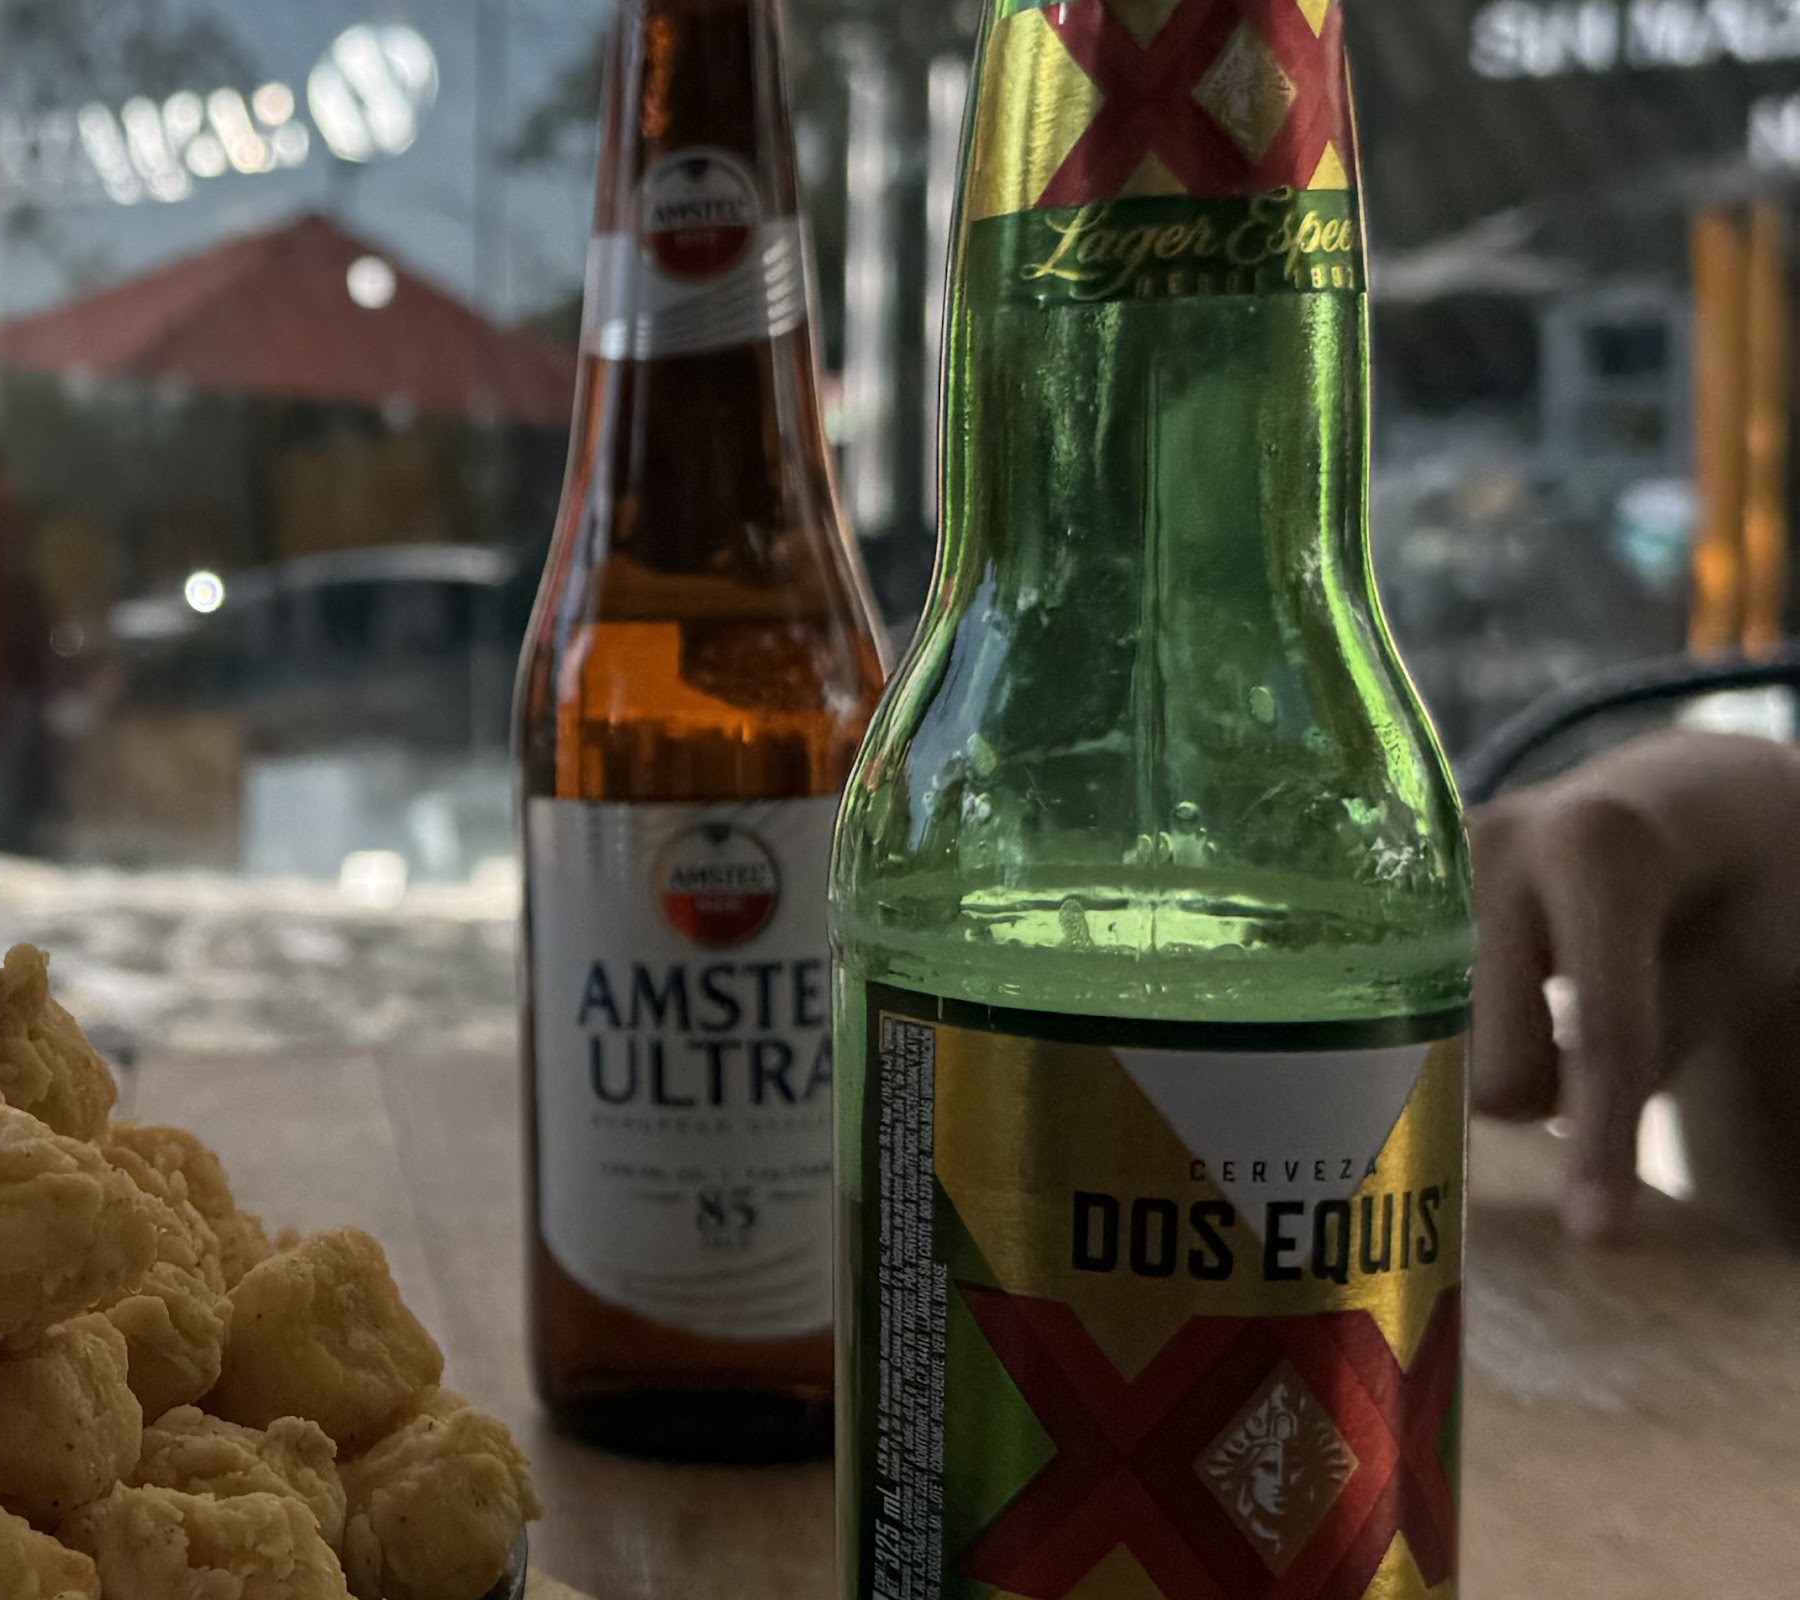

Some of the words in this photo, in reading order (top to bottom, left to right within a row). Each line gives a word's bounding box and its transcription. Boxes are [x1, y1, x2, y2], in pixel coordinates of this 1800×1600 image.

[1020, 200, 1220, 301] Lager
[578, 957, 827, 1034] AMSTE
[588, 1033, 832, 1108] ULTRA
[1188, 1156, 1378, 1184] CERVEZA
[1073, 1191, 1235, 1281] DOS
[1263, 1185, 1441, 1286] EQUIS
[875, 1485, 901, 1520] mL
[875, 1519, 901, 1571] 325
